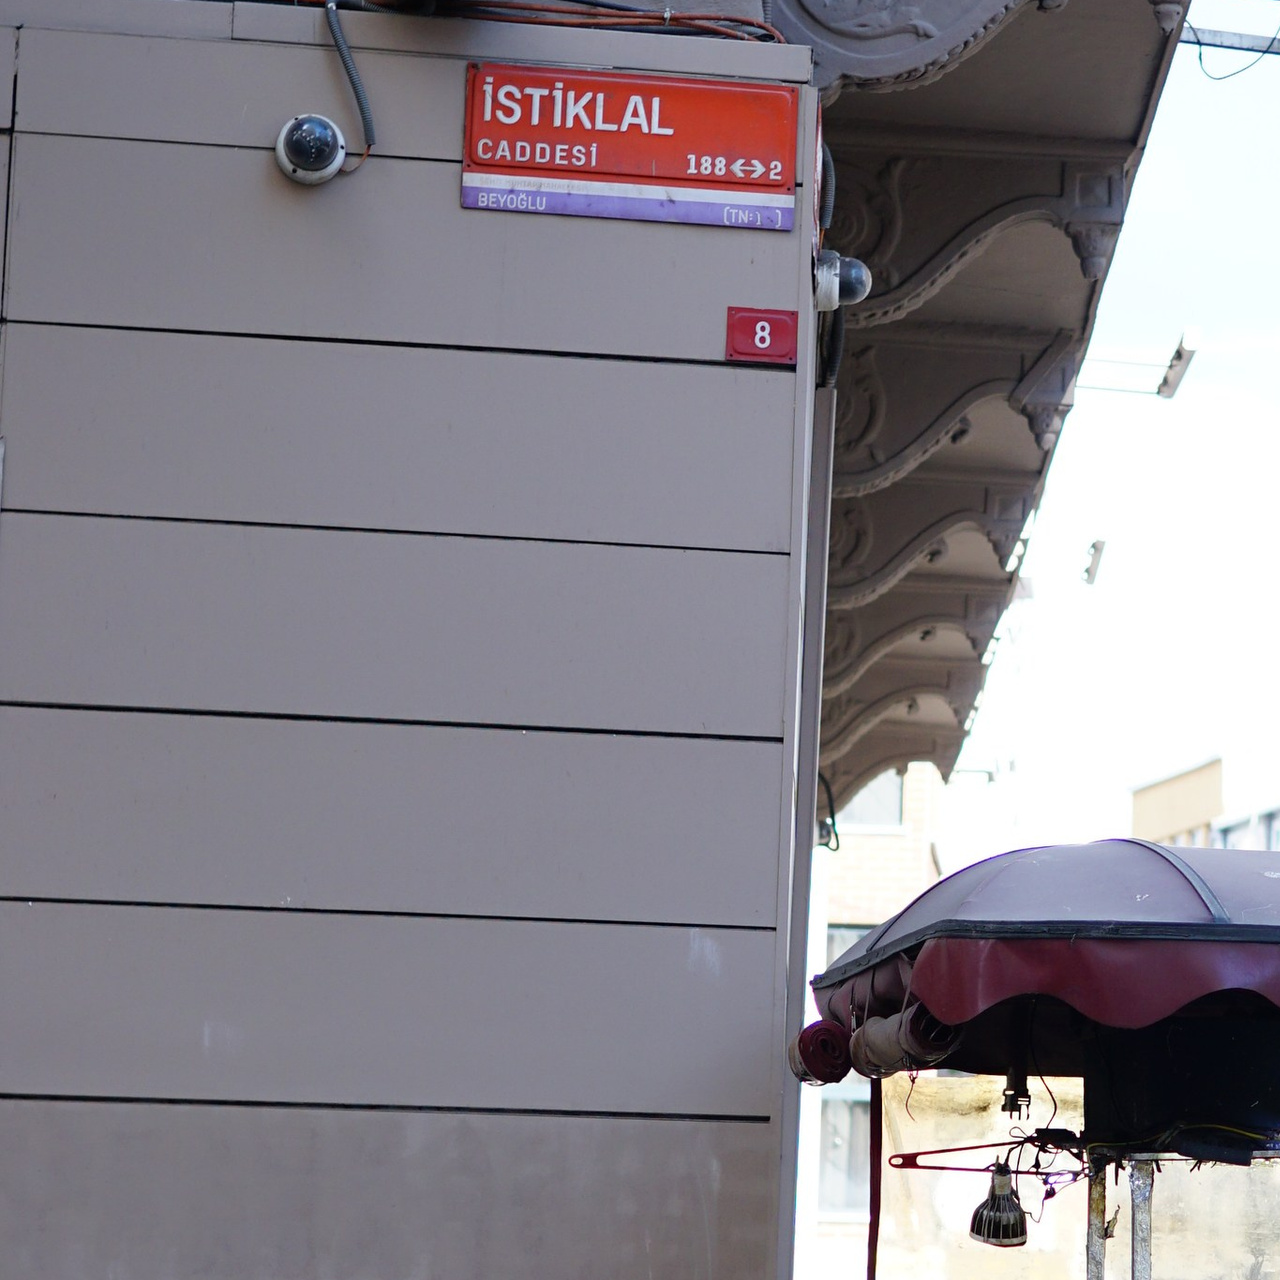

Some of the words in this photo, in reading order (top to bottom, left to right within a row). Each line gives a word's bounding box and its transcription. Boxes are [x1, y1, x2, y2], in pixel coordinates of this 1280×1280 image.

[482, 76, 674, 136] İSTİKLAL
[477, 138, 598, 167] CADDESİ
[687, 154, 726, 176] 188
[769, 160, 783, 181] 2
[478, 192, 546, 210] BEYOĞLU
[754, 321, 771, 349] 8
